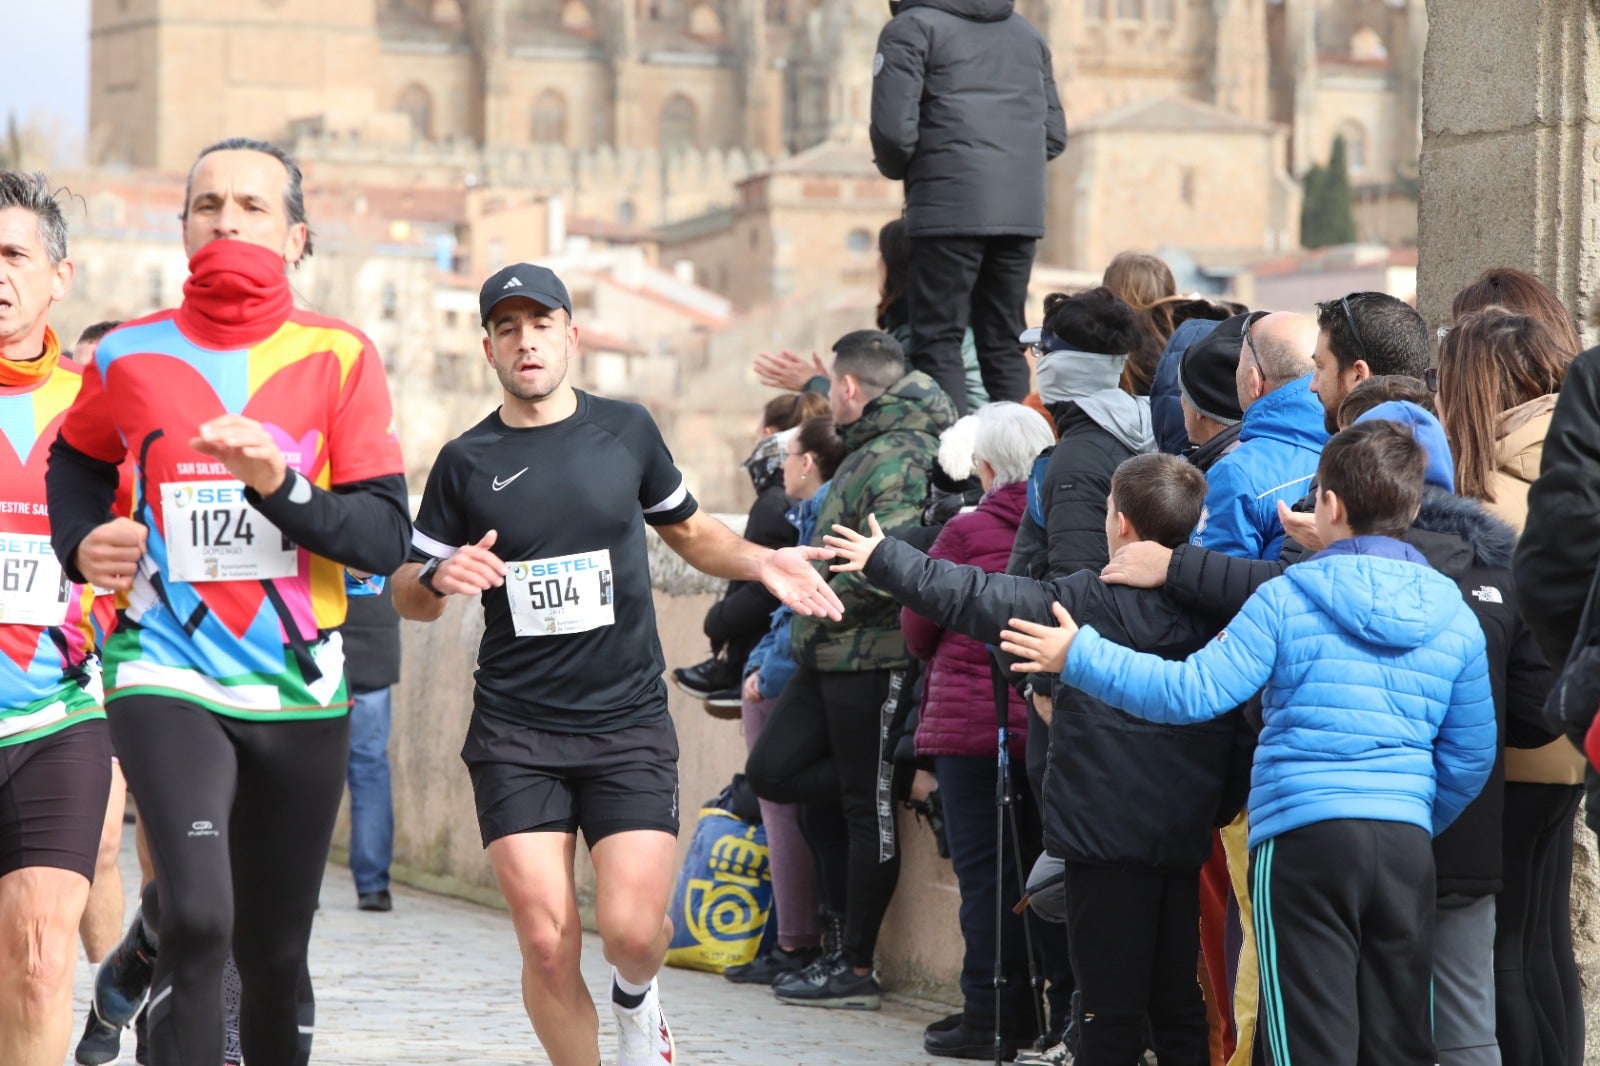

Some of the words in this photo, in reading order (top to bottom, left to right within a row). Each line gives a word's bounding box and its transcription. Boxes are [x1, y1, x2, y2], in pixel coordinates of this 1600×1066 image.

[197, 488, 246, 503] SET
[190, 509, 254, 547] 1124
[0, 538, 53, 556] SETE
[3, 558, 39, 593] 67
[531, 557, 599, 577] SETEL
[528, 576, 580, 610] 504
